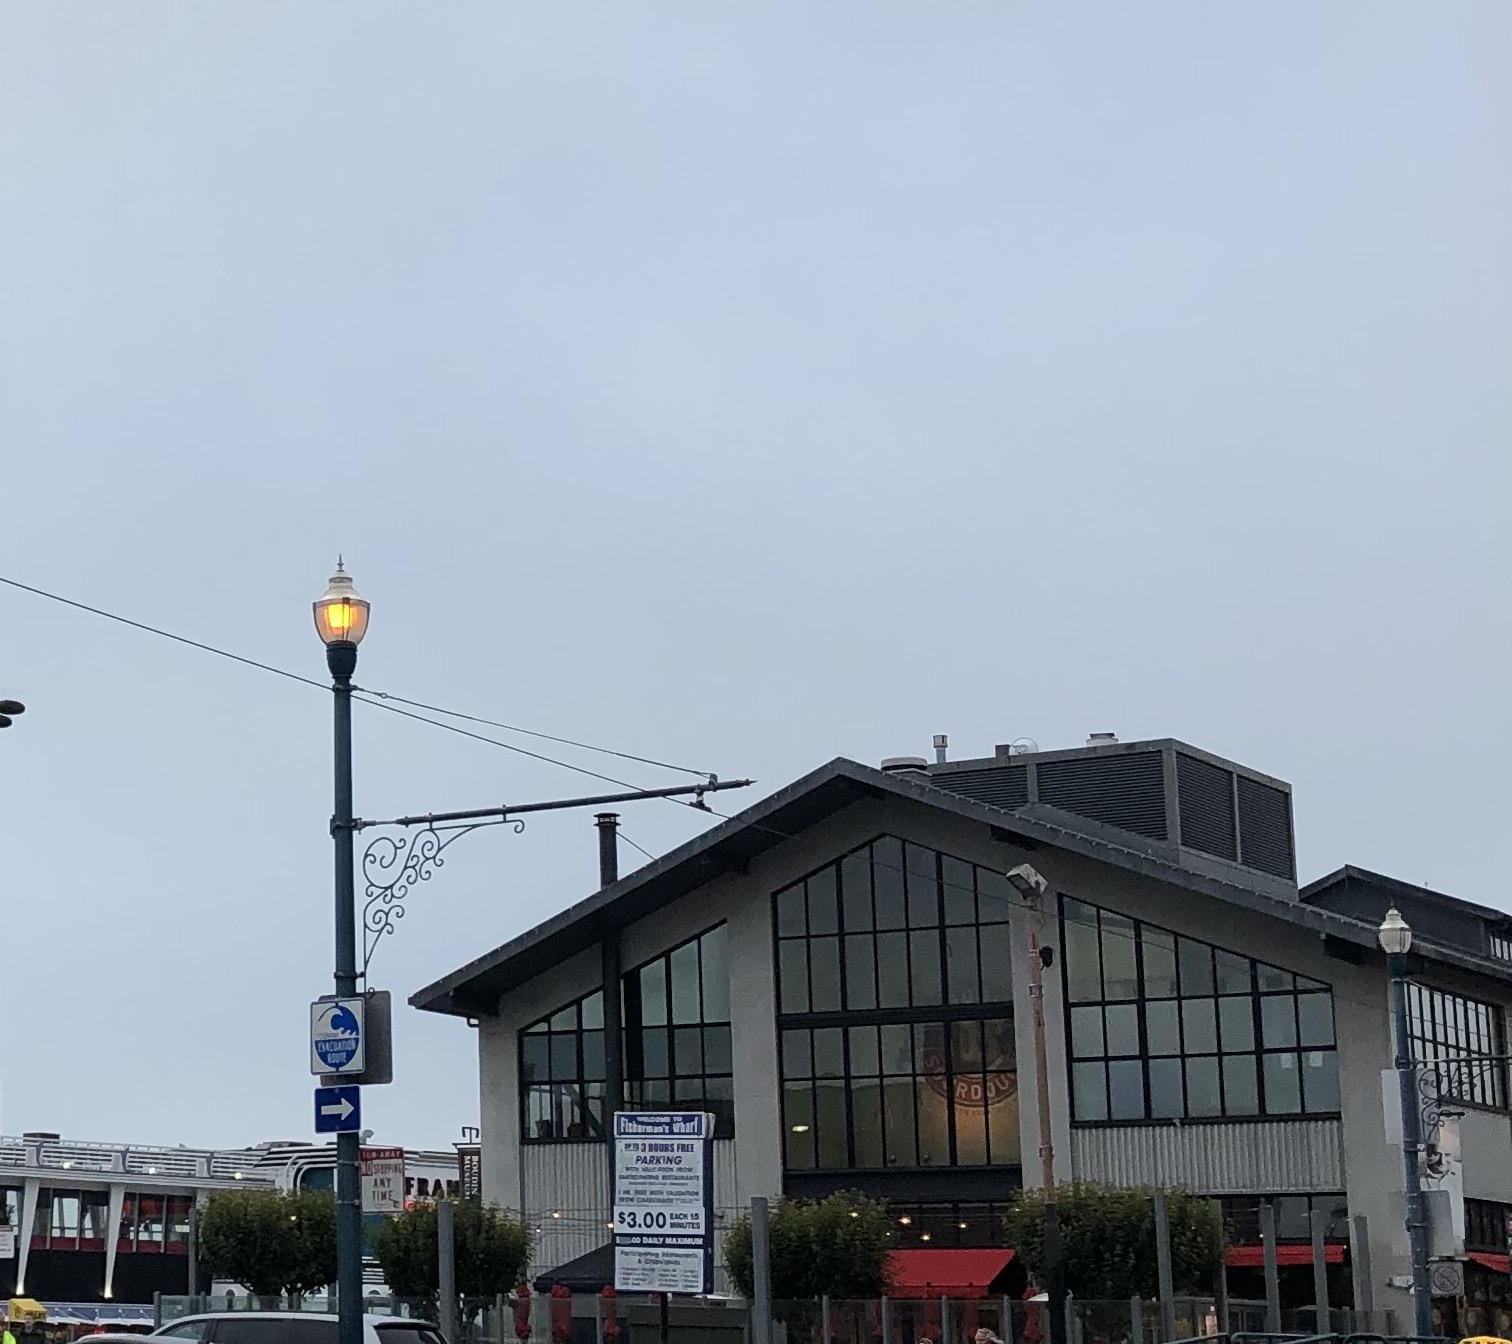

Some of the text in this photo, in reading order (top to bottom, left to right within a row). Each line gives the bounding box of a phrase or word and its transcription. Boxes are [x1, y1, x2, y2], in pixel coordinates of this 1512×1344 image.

[635, 1155, 684, 1165] PARKING
[617, 1211, 667, 1229] $3.00
[670, 1212, 688, 1220] EACH
